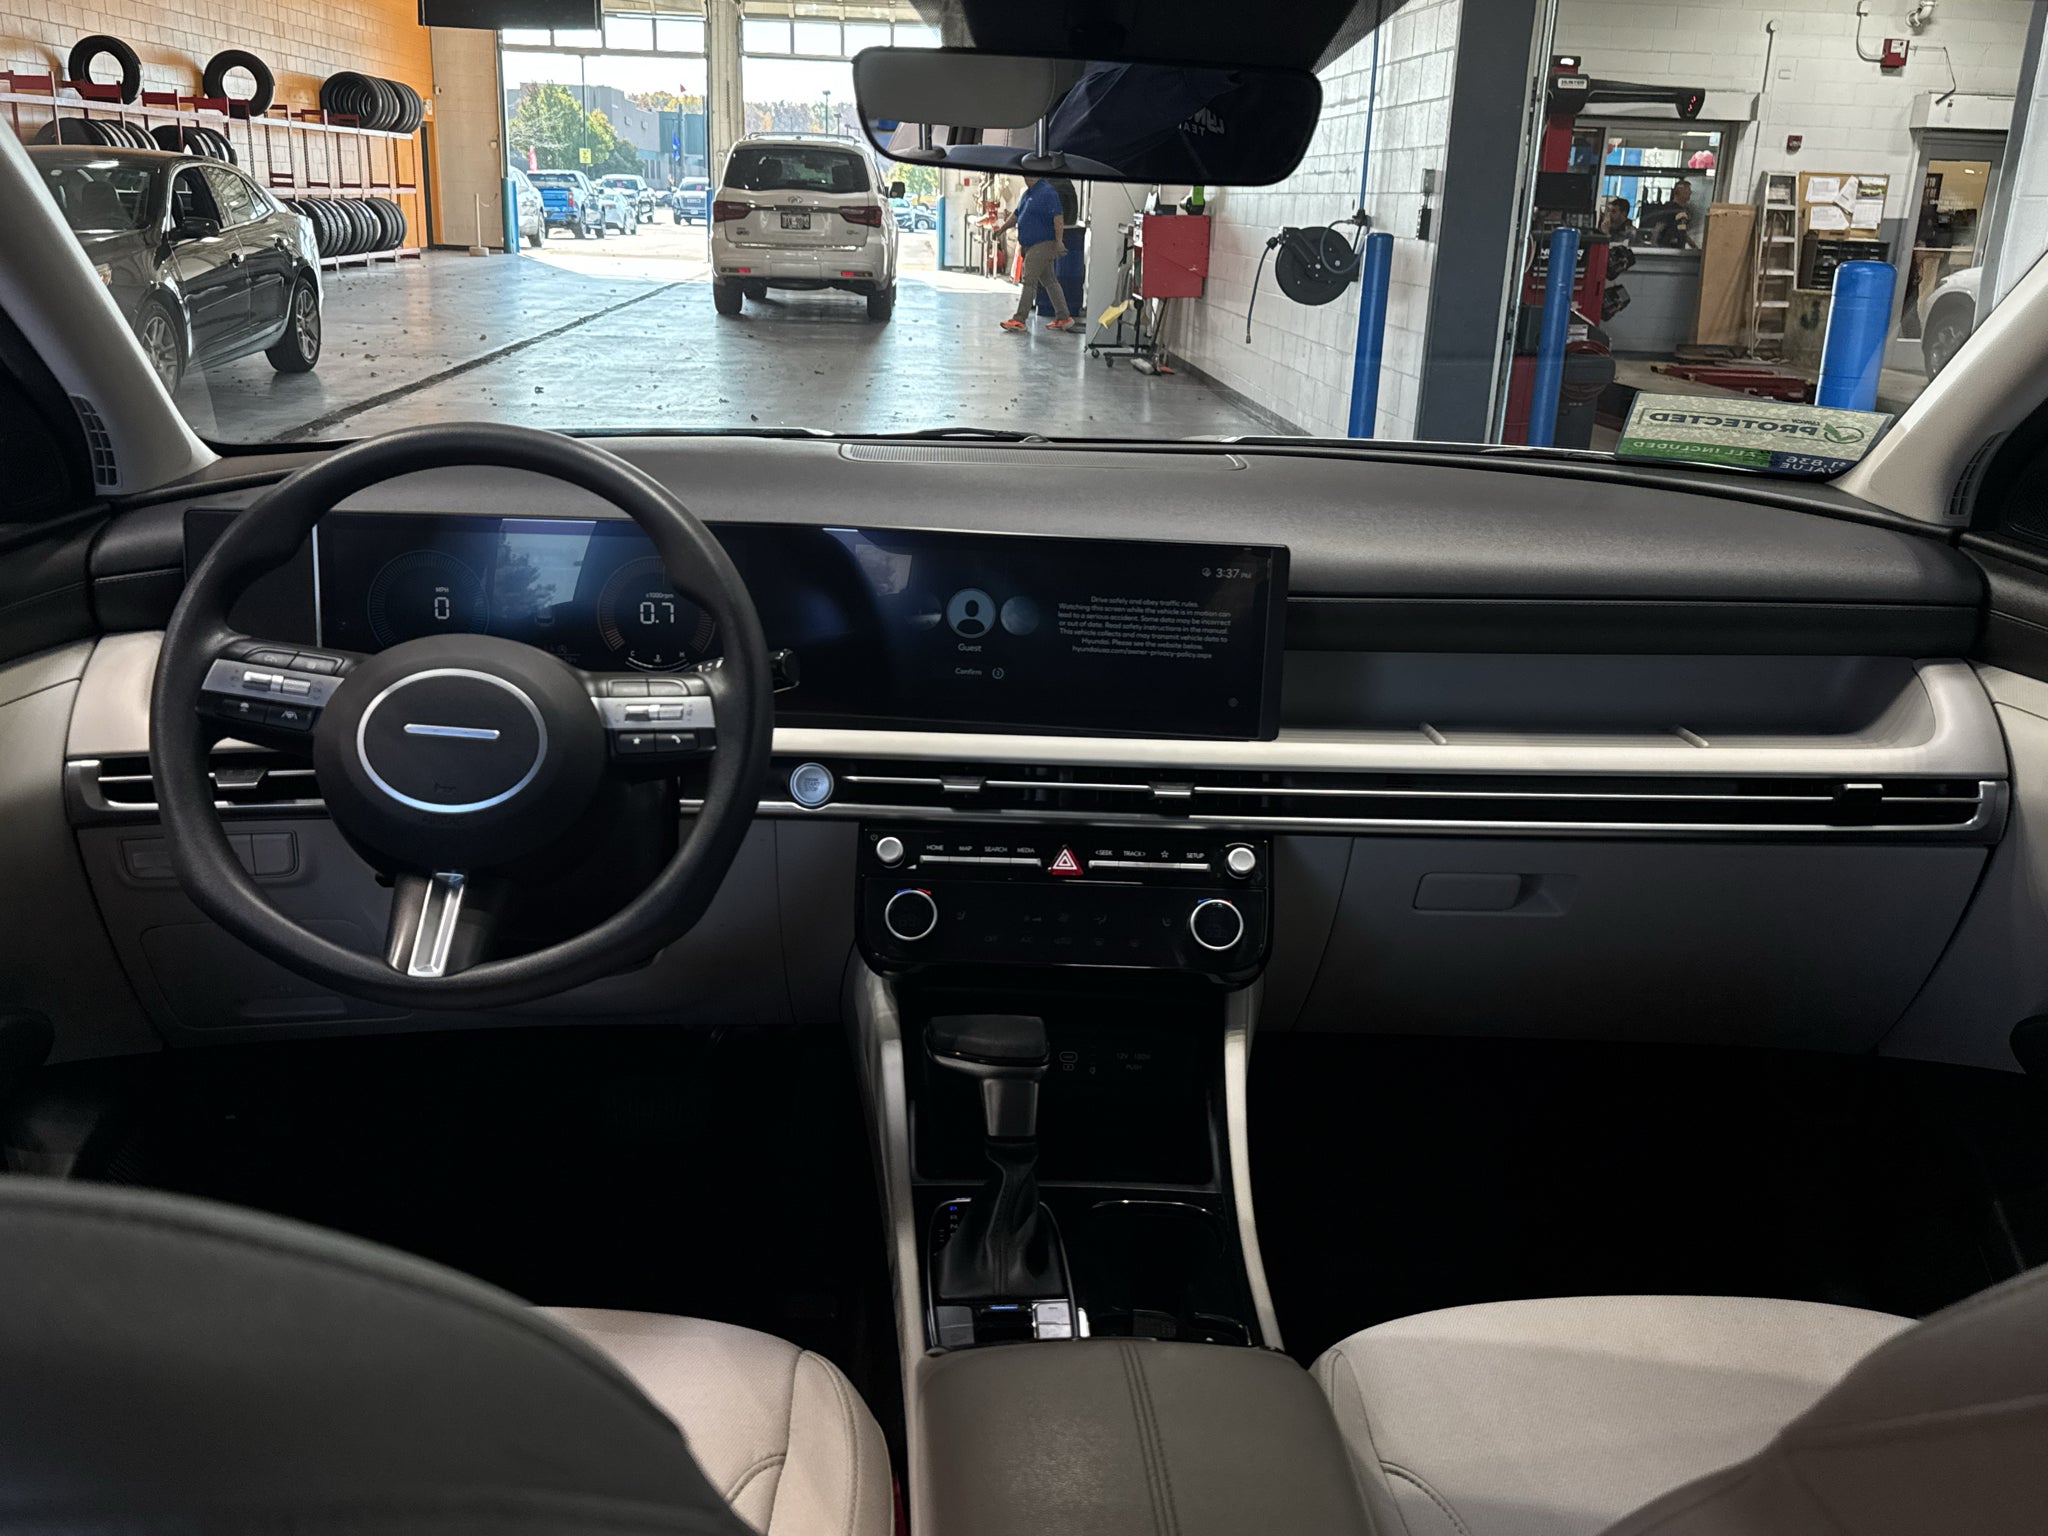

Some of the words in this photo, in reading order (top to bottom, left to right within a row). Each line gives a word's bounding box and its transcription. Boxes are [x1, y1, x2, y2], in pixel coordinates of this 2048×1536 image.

[1215, 568, 1240, 578] 3:37
[1109, 597, 1128, 606] safely
[1143, 599, 1158, 607] obey
[434, 597, 450, 620] 0
[1059, 603, 1090, 612] Watching
[639, 602, 675, 624] 0.7
[1087, 612, 1109, 620] serious
[1141, 615, 1158, 623] Some
[1160, 616, 1175, 624] data
[1201, 618, 1231, 626] incorrect
[1122, 623, 1142, 632] safety
[1143, 624, 1181, 632] instructions
[1181, 634, 1202, 642] vehicle
[957, 643, 982, 652] Guest
[1157, 641, 1181, 649] website
[954, 667, 982, 676] Confirm
